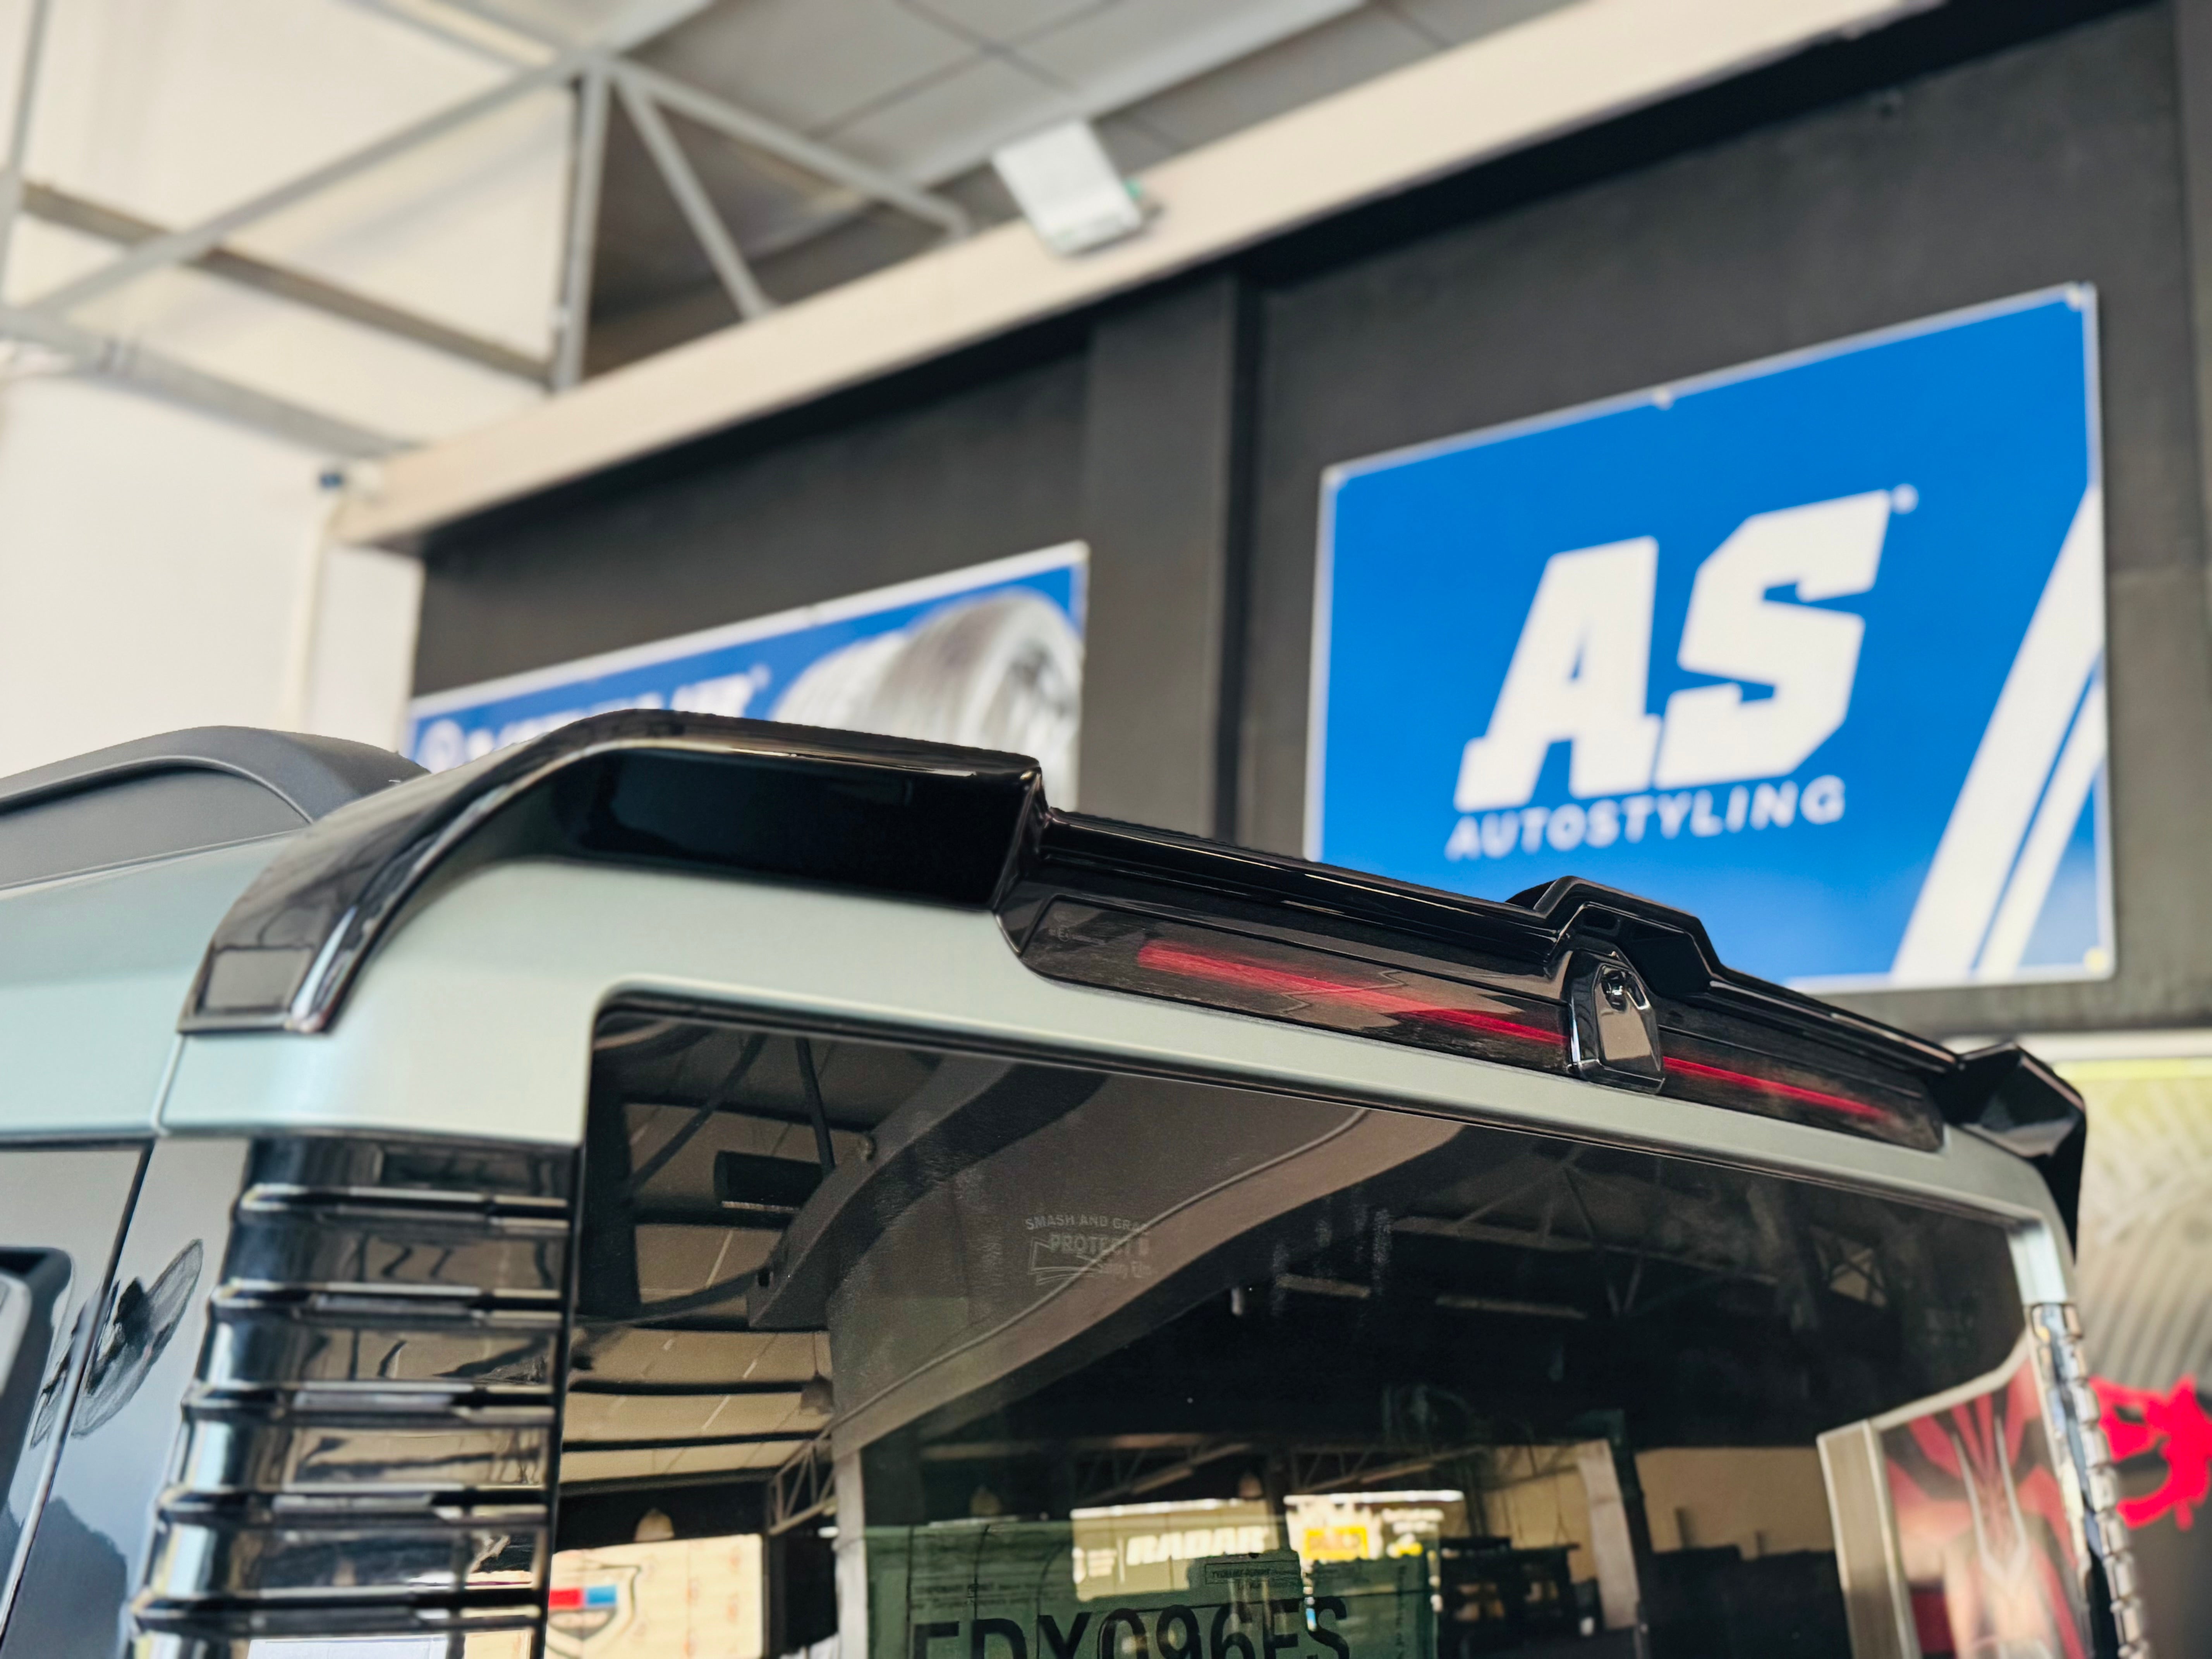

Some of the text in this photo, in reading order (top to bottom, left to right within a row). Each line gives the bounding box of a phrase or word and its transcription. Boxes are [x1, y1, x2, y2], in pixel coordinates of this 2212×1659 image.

[1453, 488, 1891, 813] AS
[1444, 775, 1846, 861] AUTOSTYLING
[1025, 1214, 1075, 1230] SMASH
[1079, 1214, 1108, 1228] AND
